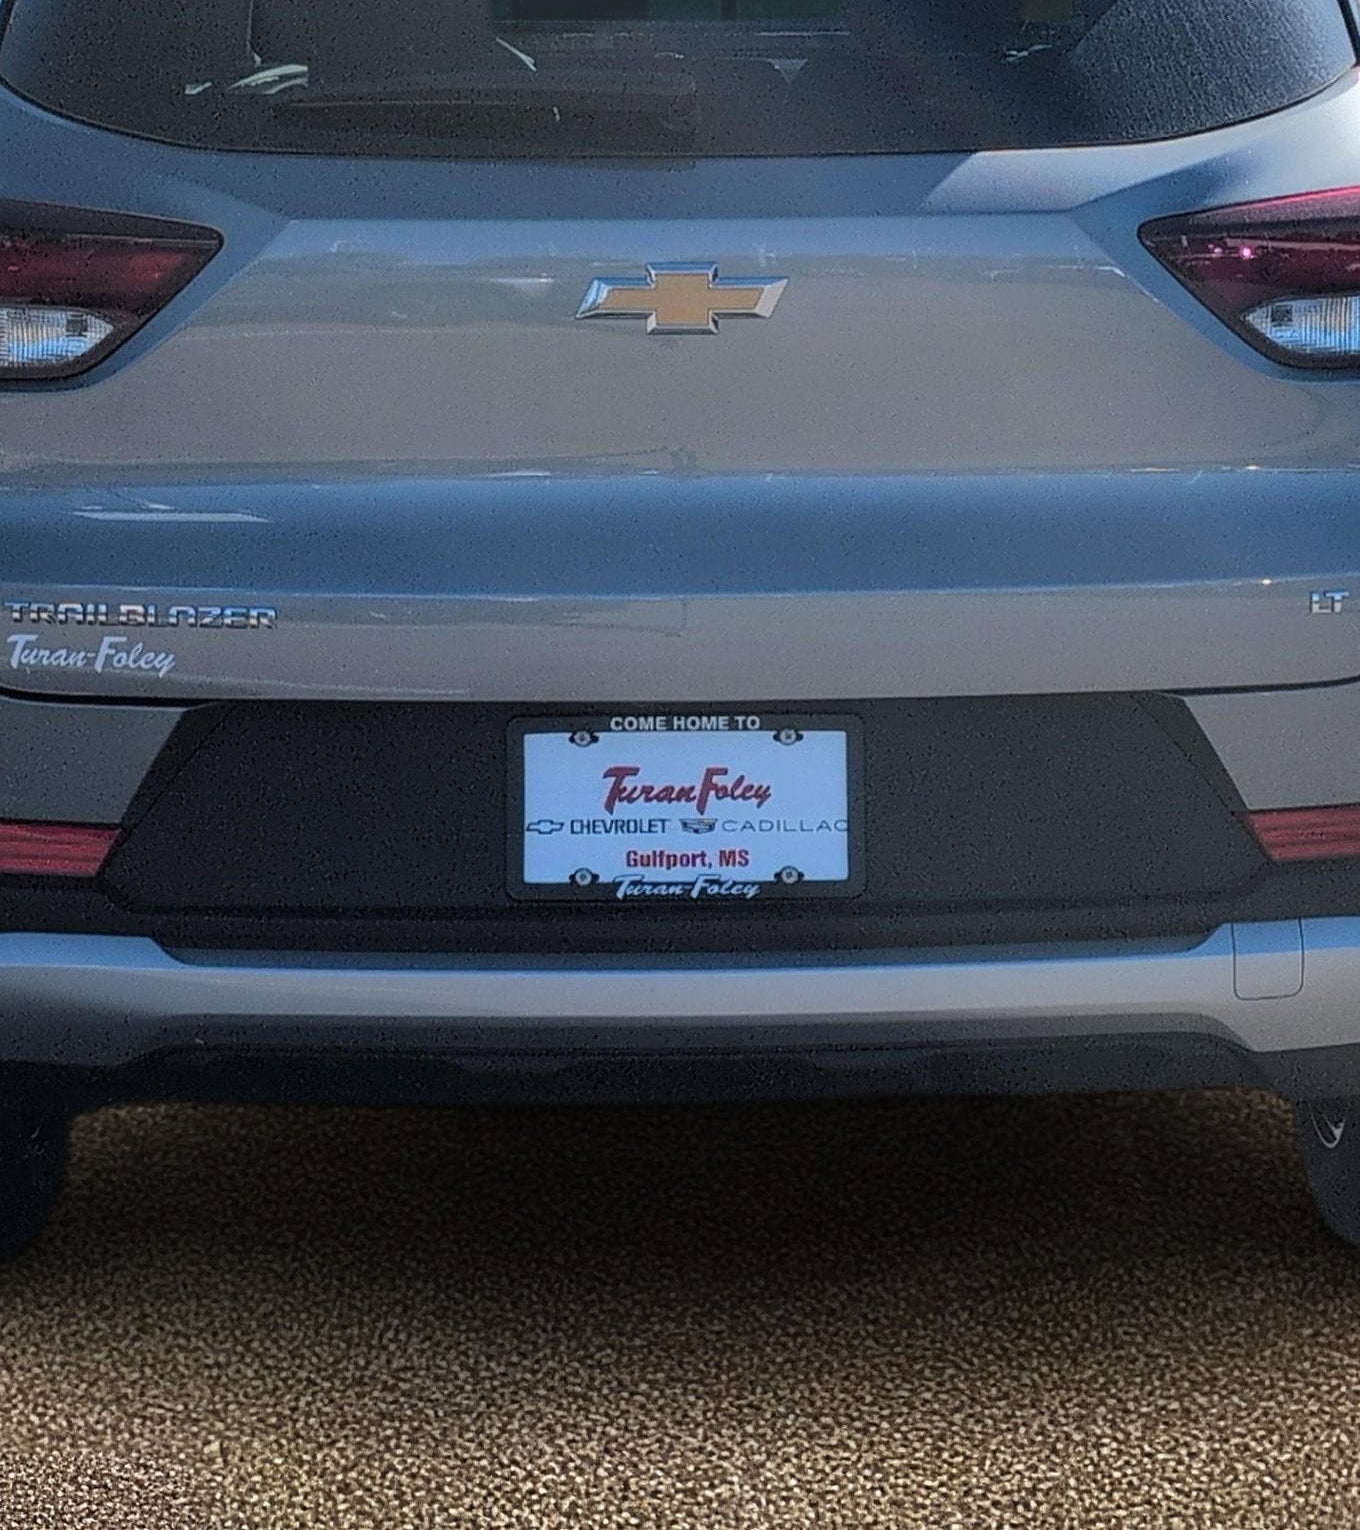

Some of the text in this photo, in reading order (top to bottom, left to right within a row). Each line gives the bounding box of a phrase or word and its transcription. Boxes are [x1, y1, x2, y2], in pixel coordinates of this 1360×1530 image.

[1310, 590, 1349, 614] LT
[4, 601, 277, 629] TRAILBLAZER
[610, 715, 761, 731] COME HOME TO
[570, 818, 849, 834] CHEVROLET CADILLAC
[626, 849, 750, 869] Gulfport, MS
